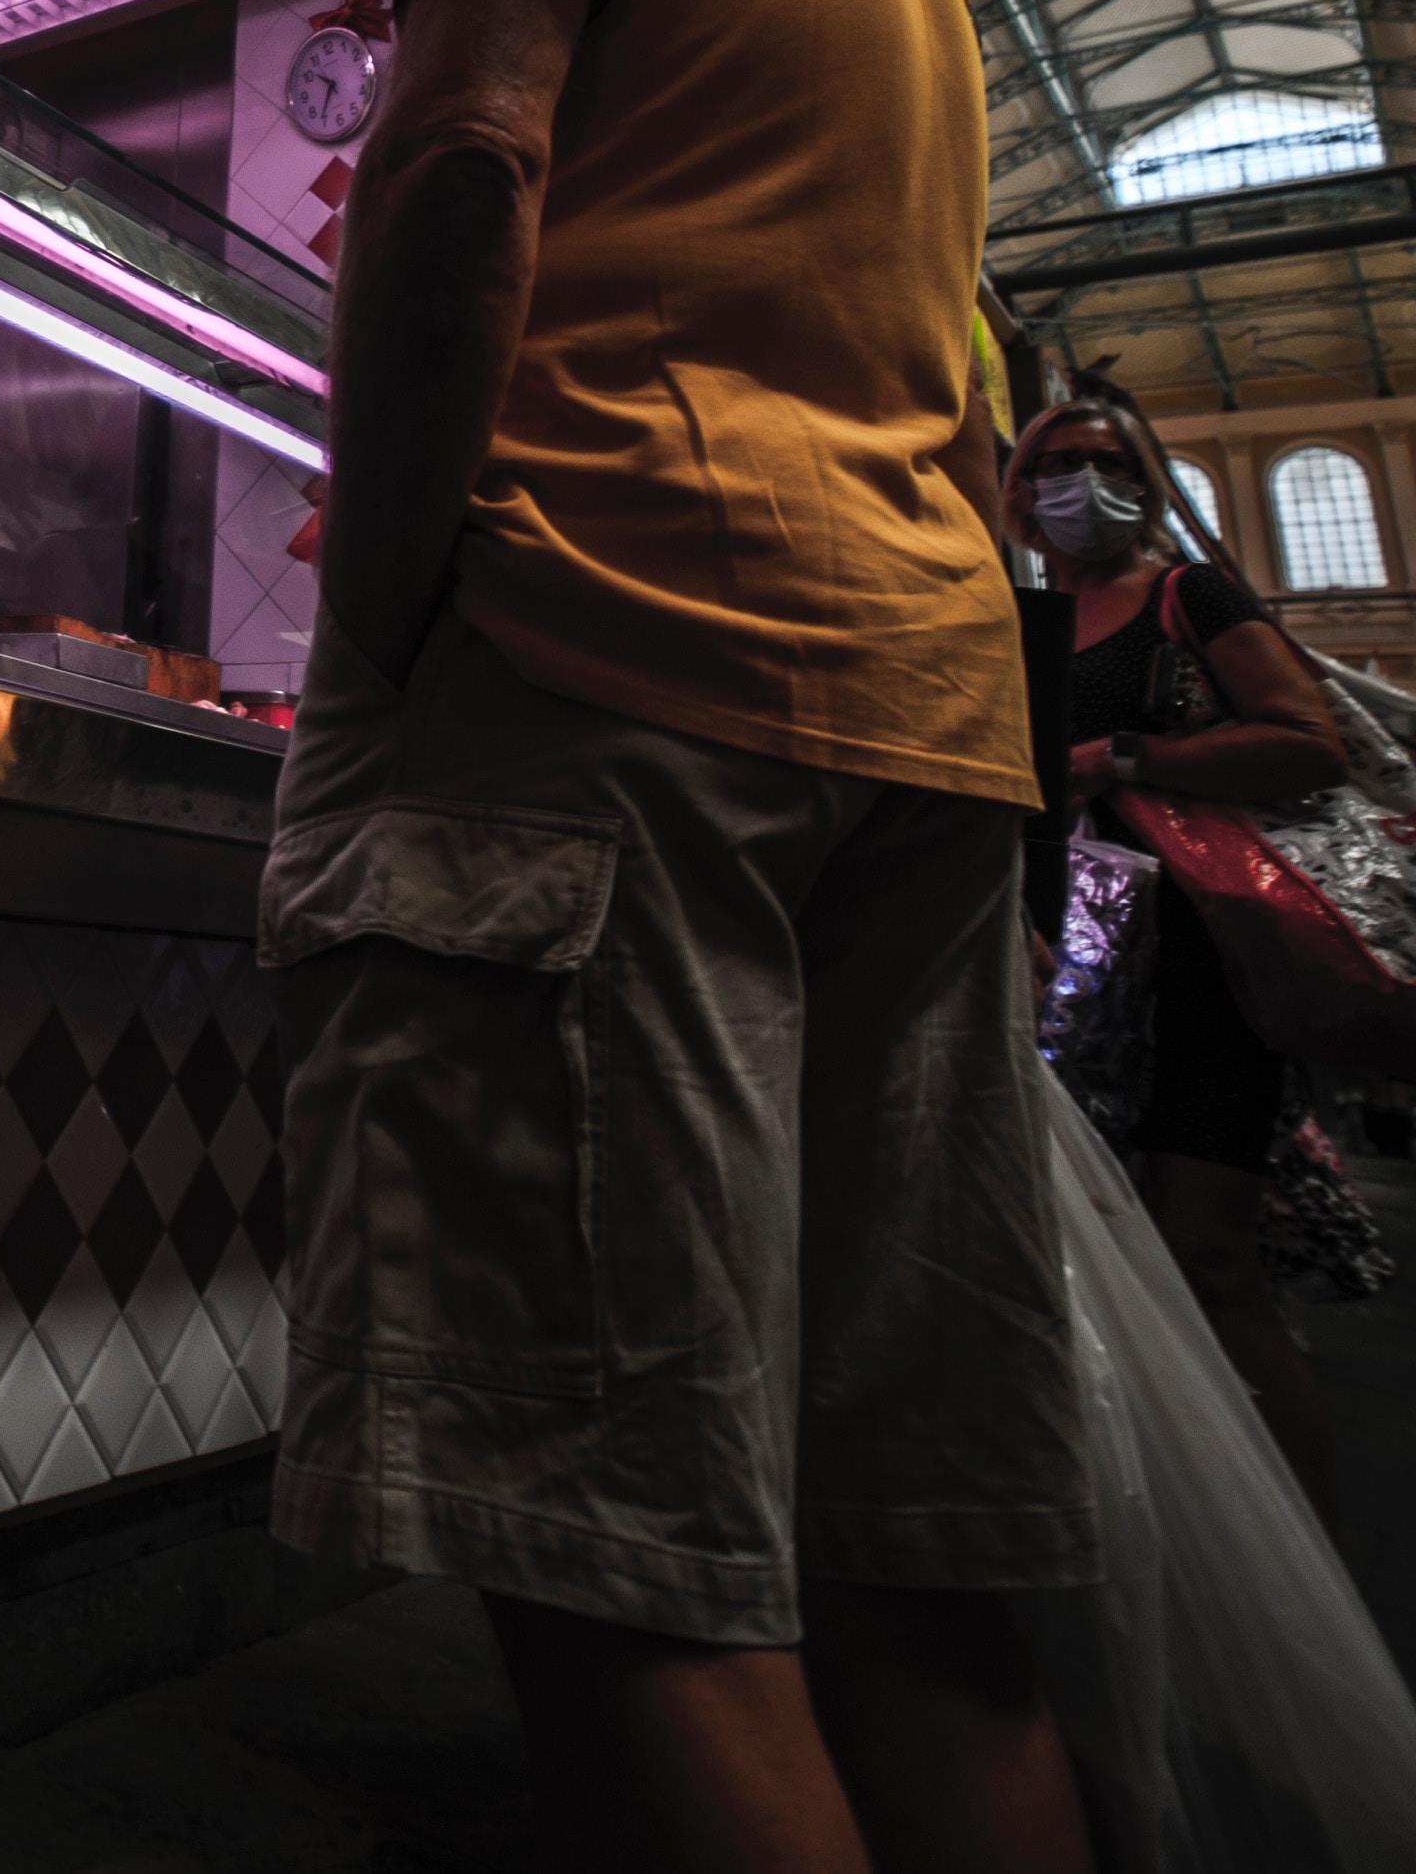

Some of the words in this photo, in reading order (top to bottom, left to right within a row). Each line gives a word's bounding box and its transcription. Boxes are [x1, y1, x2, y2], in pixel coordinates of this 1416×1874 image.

[352, 47, 362, 63] 2
[349, 101, 359, 116] 5
[336, 113, 345, 127] 6
